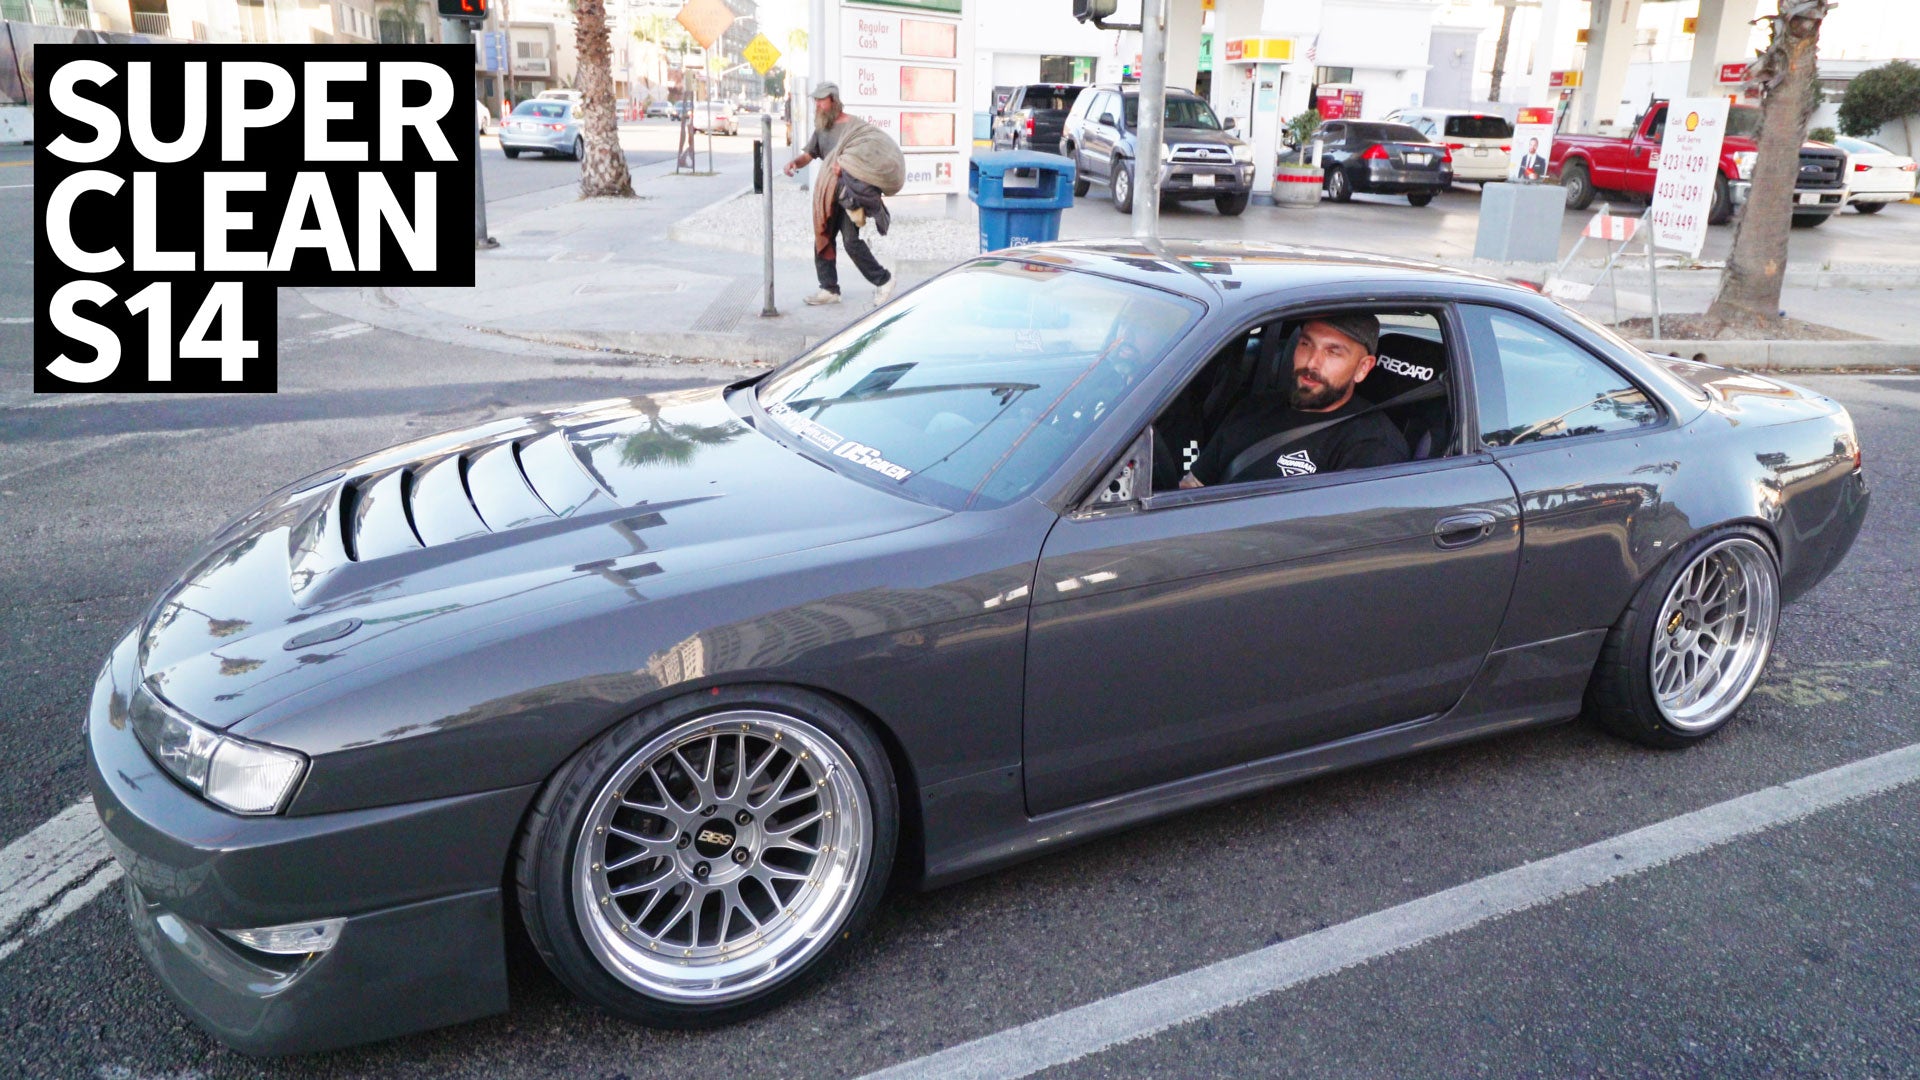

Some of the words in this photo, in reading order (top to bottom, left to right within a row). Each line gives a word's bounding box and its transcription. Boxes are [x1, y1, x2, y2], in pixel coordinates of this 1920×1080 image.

[858, 19, 889, 36] Regular
[858, 36, 878, 49] Cash
[858, 68, 875, 81] Plus
[858, 83, 878, 95] Cash
[1686, 154, 1704, 172] 429
[1681, 185, 1698, 202] 439
[1377, 354, 1434, 381] RECARO
[698, 830, 734, 846] BBS
